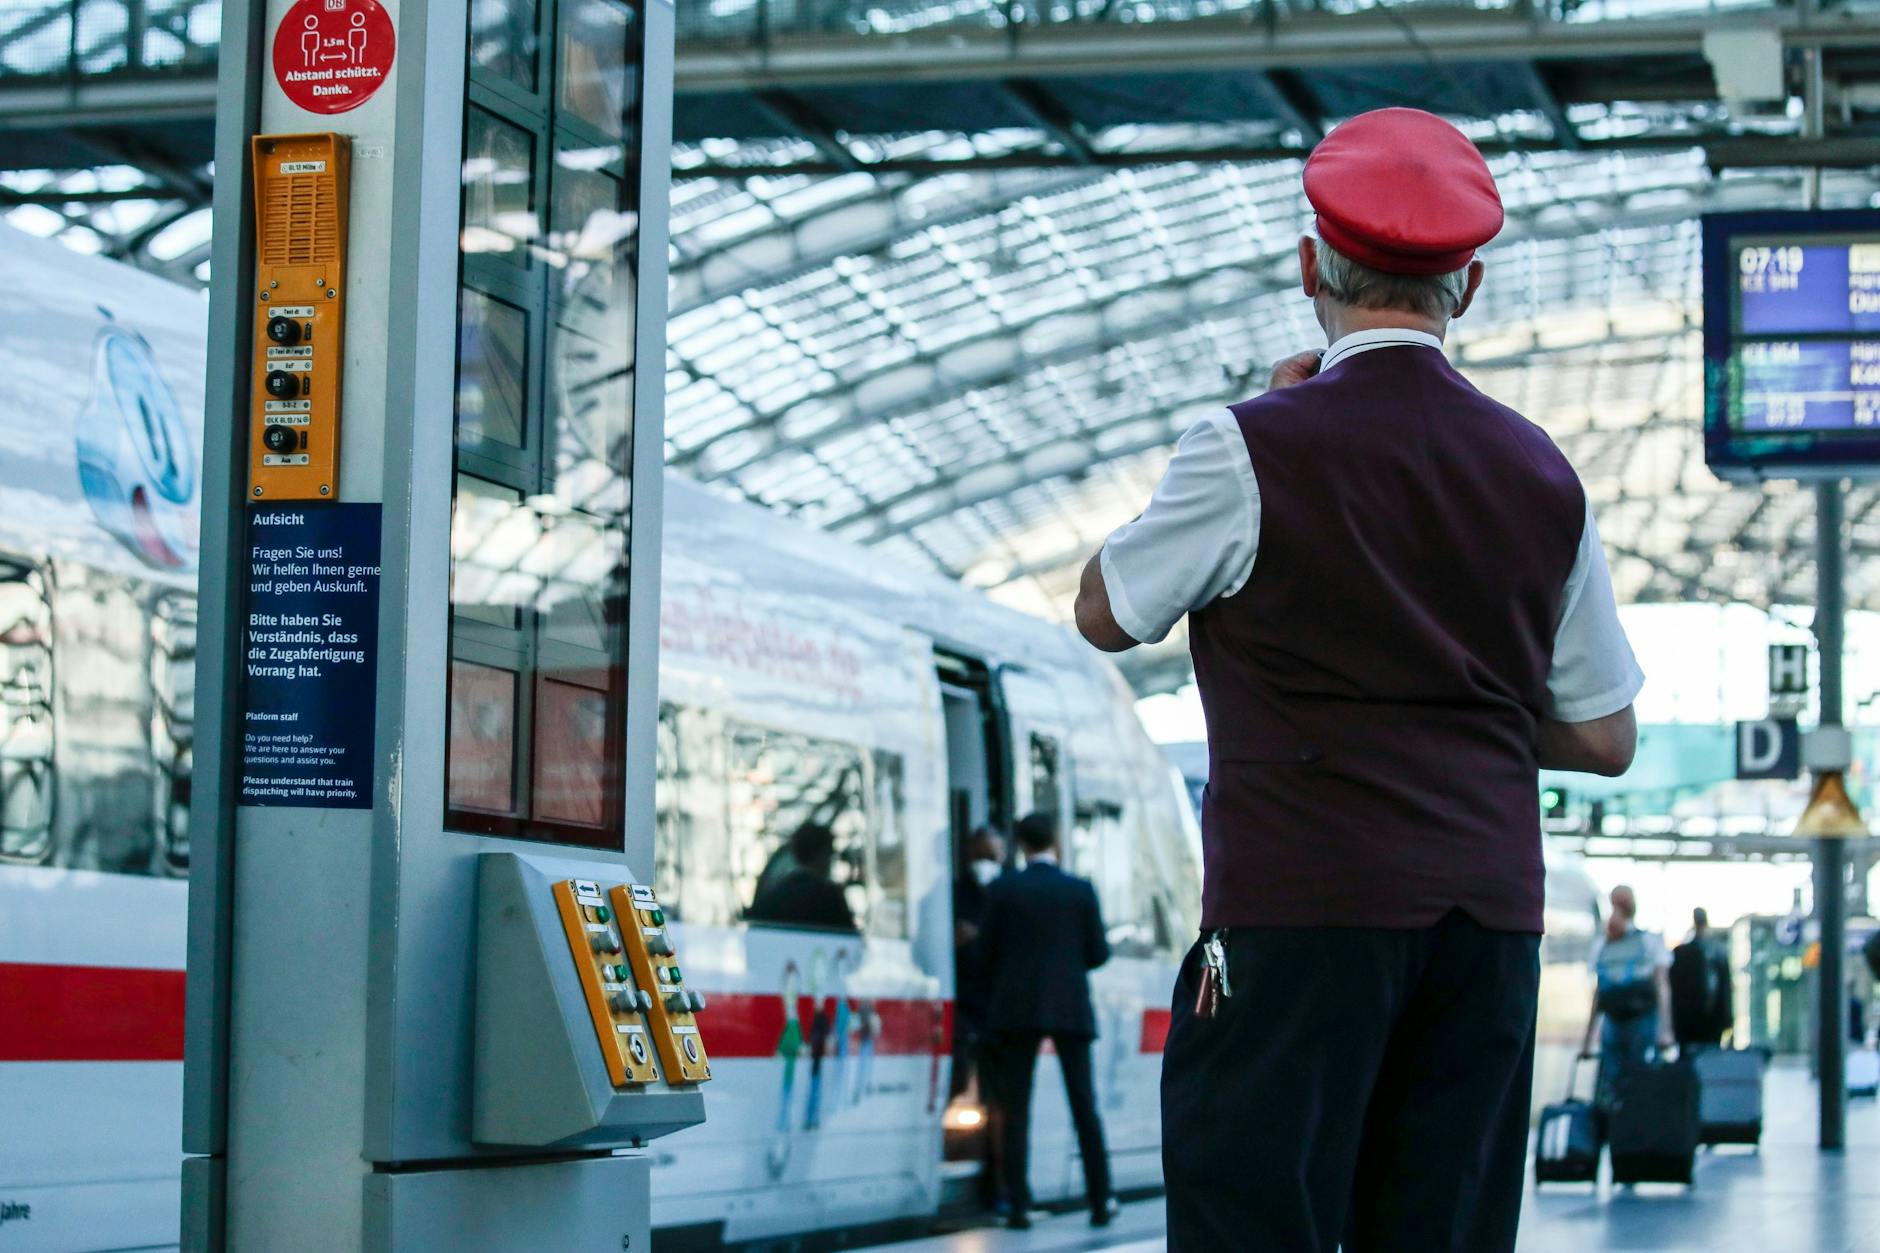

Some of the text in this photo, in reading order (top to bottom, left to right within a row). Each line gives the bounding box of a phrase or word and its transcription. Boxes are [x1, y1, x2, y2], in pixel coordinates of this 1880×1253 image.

[286, 66, 381, 81] Abstand schützt.
[313, 85, 352, 96] Danke.
[1740, 247, 1803, 274] 07:19
[253, 514, 304, 525] Aufsicht
[252, 547, 342, 561] Fragen Sie uns!
[252, 564, 381, 578] Wir helfen Ihnen gerne
[251, 581, 368, 595] und geben Auskunft.
[250, 614, 342, 625] Bitte haben Sie
[249, 631, 358, 644] Verständnis, dass
[248, 648, 364, 663] die Zugabfertigung
[248, 665, 321, 679] Vorrang hat.
[1772, 646, 1805, 690] H
[246, 712, 298, 721] Platform staff
[293, 735, 313, 744] help?
[1741, 718, 1783, 772] D
[243, 776, 269, 784] Please
[271, 777, 315, 785] understand
[335, 778, 353, 786] train
[243, 787, 288, 797] dispatching
[306, 788, 324, 796] have
[327, 789, 357, 798] priority.
